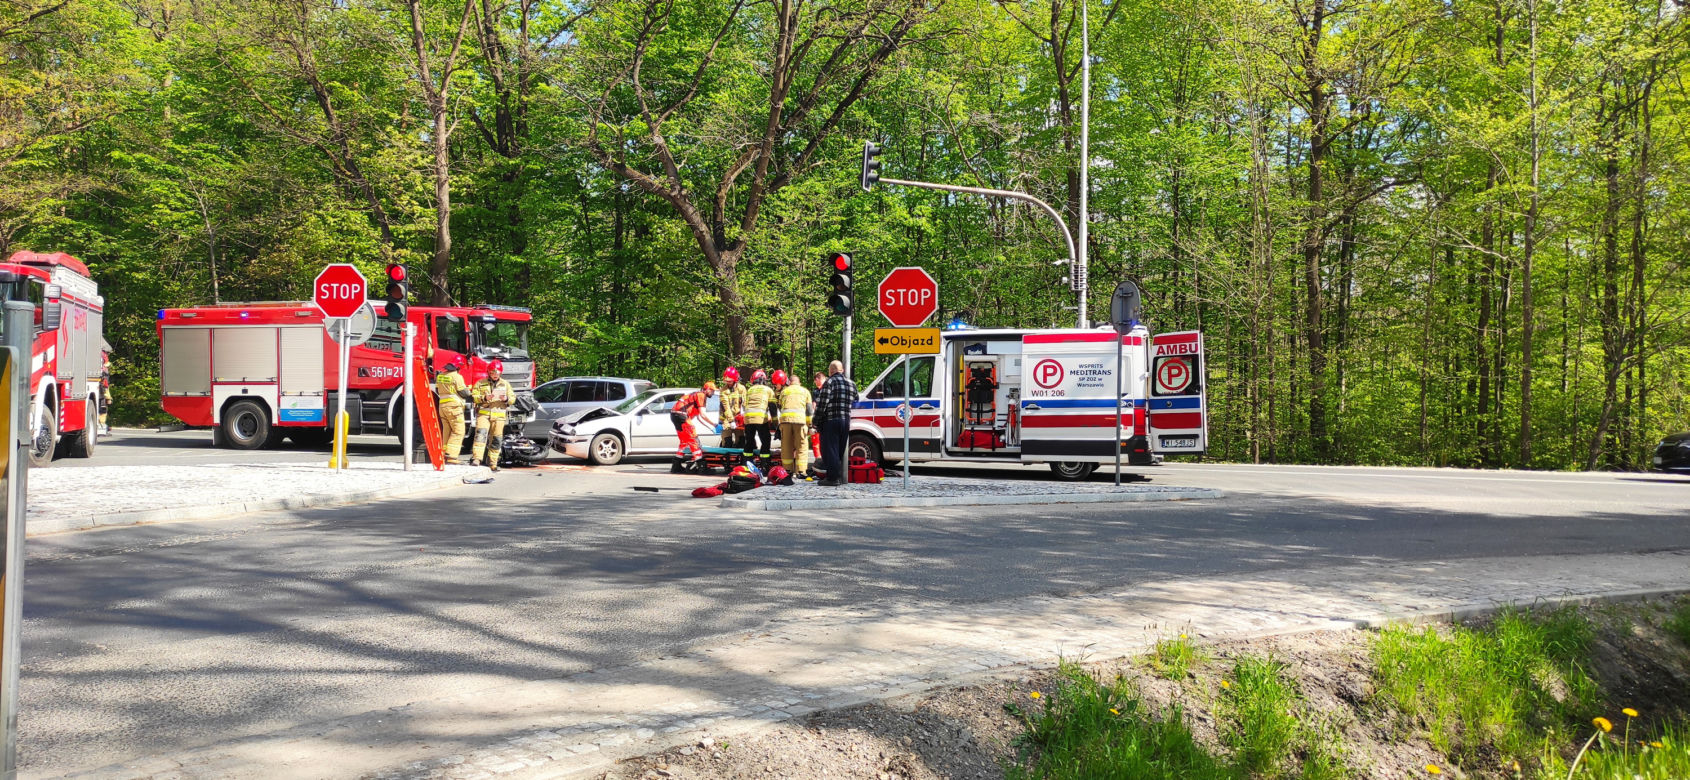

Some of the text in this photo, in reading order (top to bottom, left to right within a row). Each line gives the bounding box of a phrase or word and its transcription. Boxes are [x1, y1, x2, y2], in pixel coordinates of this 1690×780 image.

[320, 283, 361, 300] STOP
[885, 288, 931, 306] STOP
[890, 335, 933, 348] Objazd
[1156, 343, 1198, 356] AMBU
[1042, 364, 1058, 384] P
[1167, 365, 1183, 386] P
